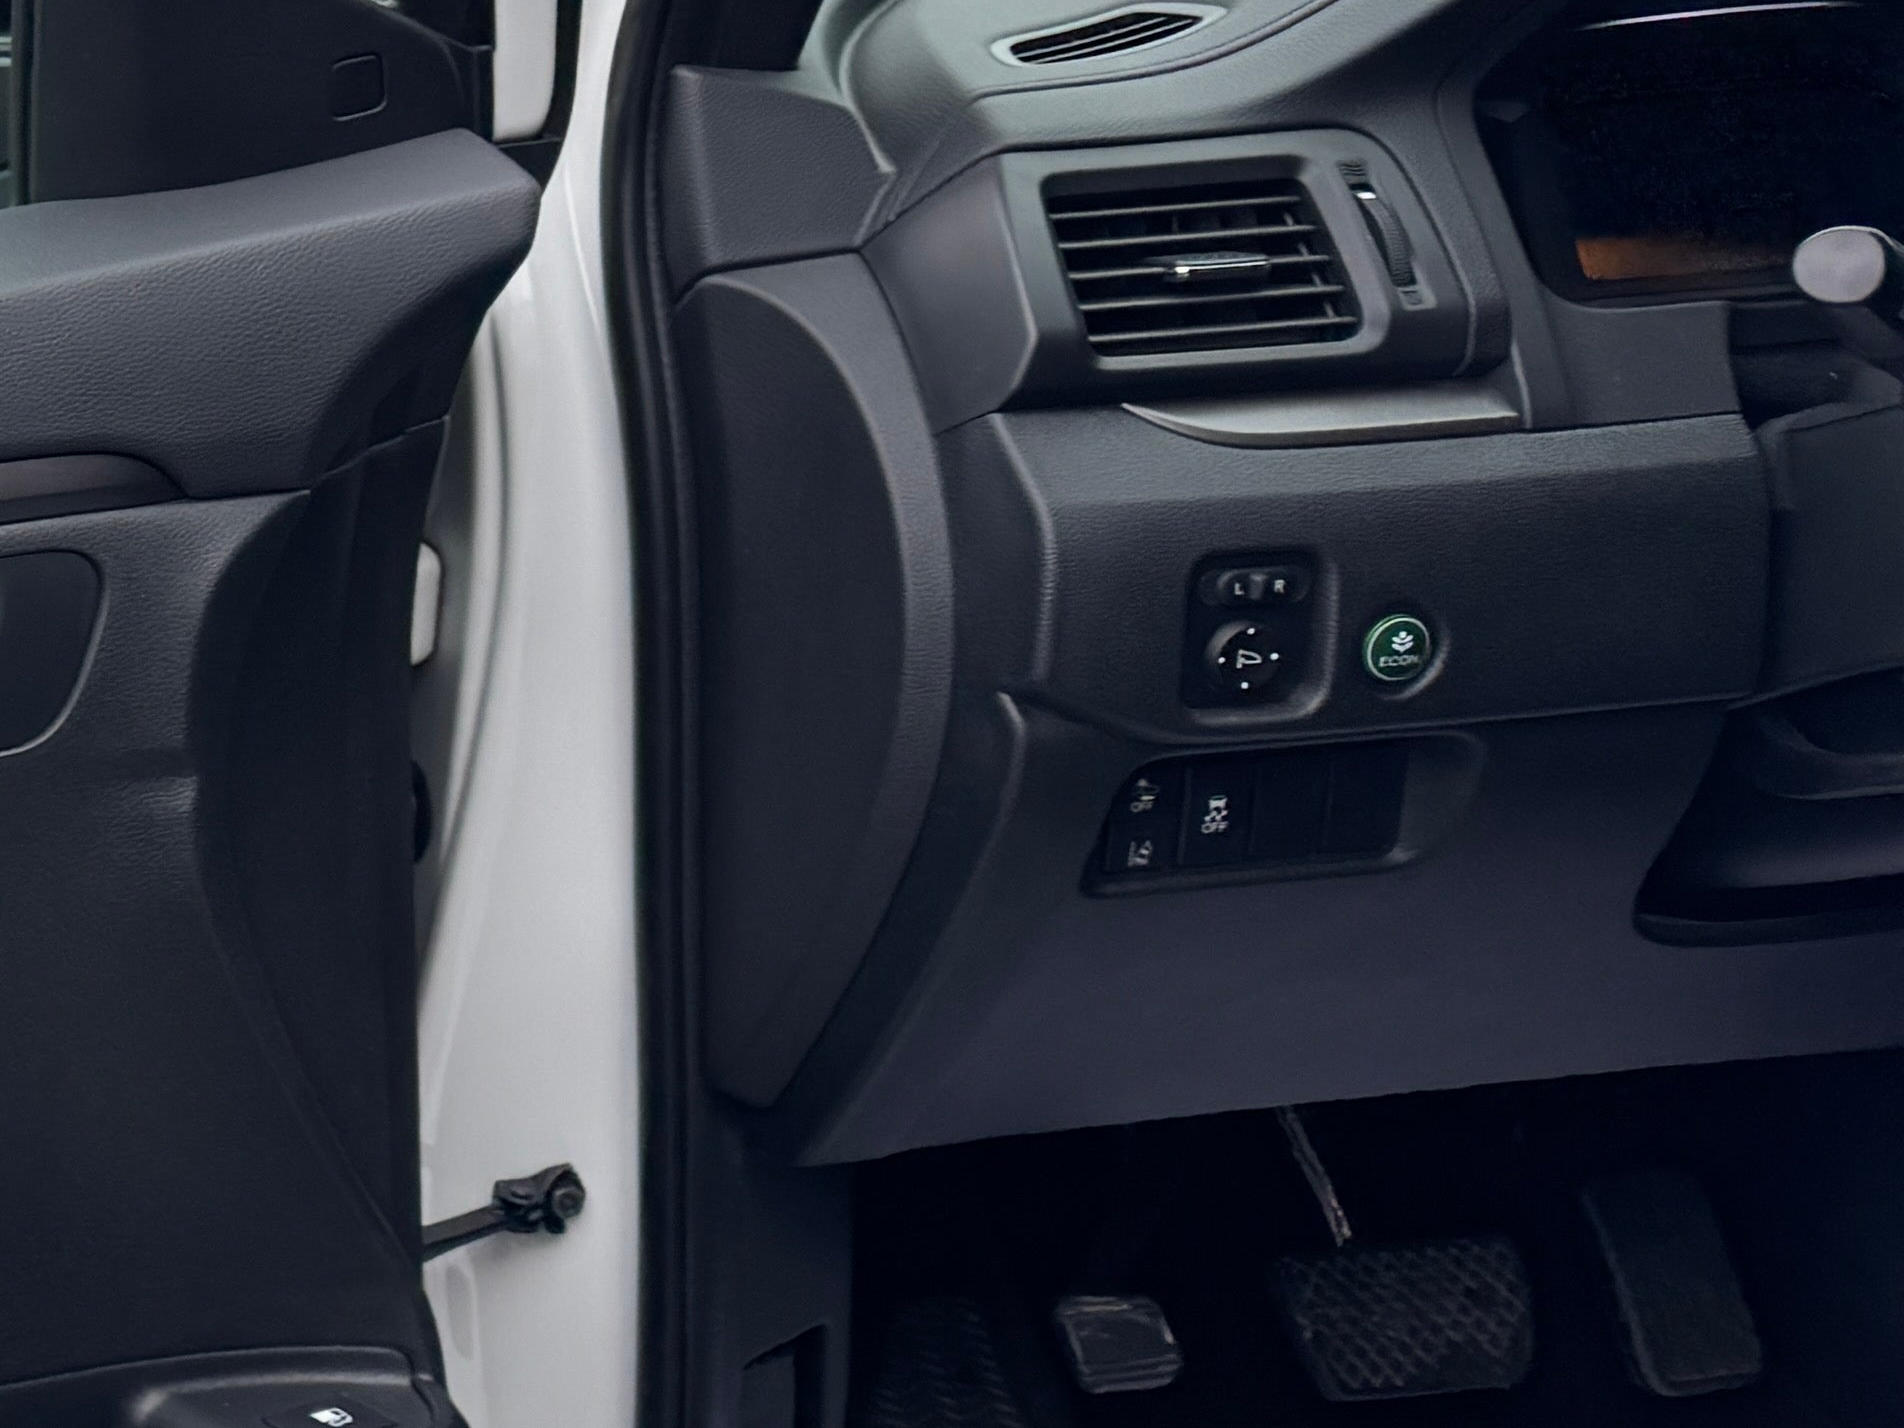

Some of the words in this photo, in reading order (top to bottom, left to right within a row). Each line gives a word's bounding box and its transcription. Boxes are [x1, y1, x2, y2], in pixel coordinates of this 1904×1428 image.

[1234, 582, 1244, 595] L
[1274, 579, 1285, 593] R
[1378, 655, 1420, 668] ECON
[1201, 821, 1229, 834] OFF
